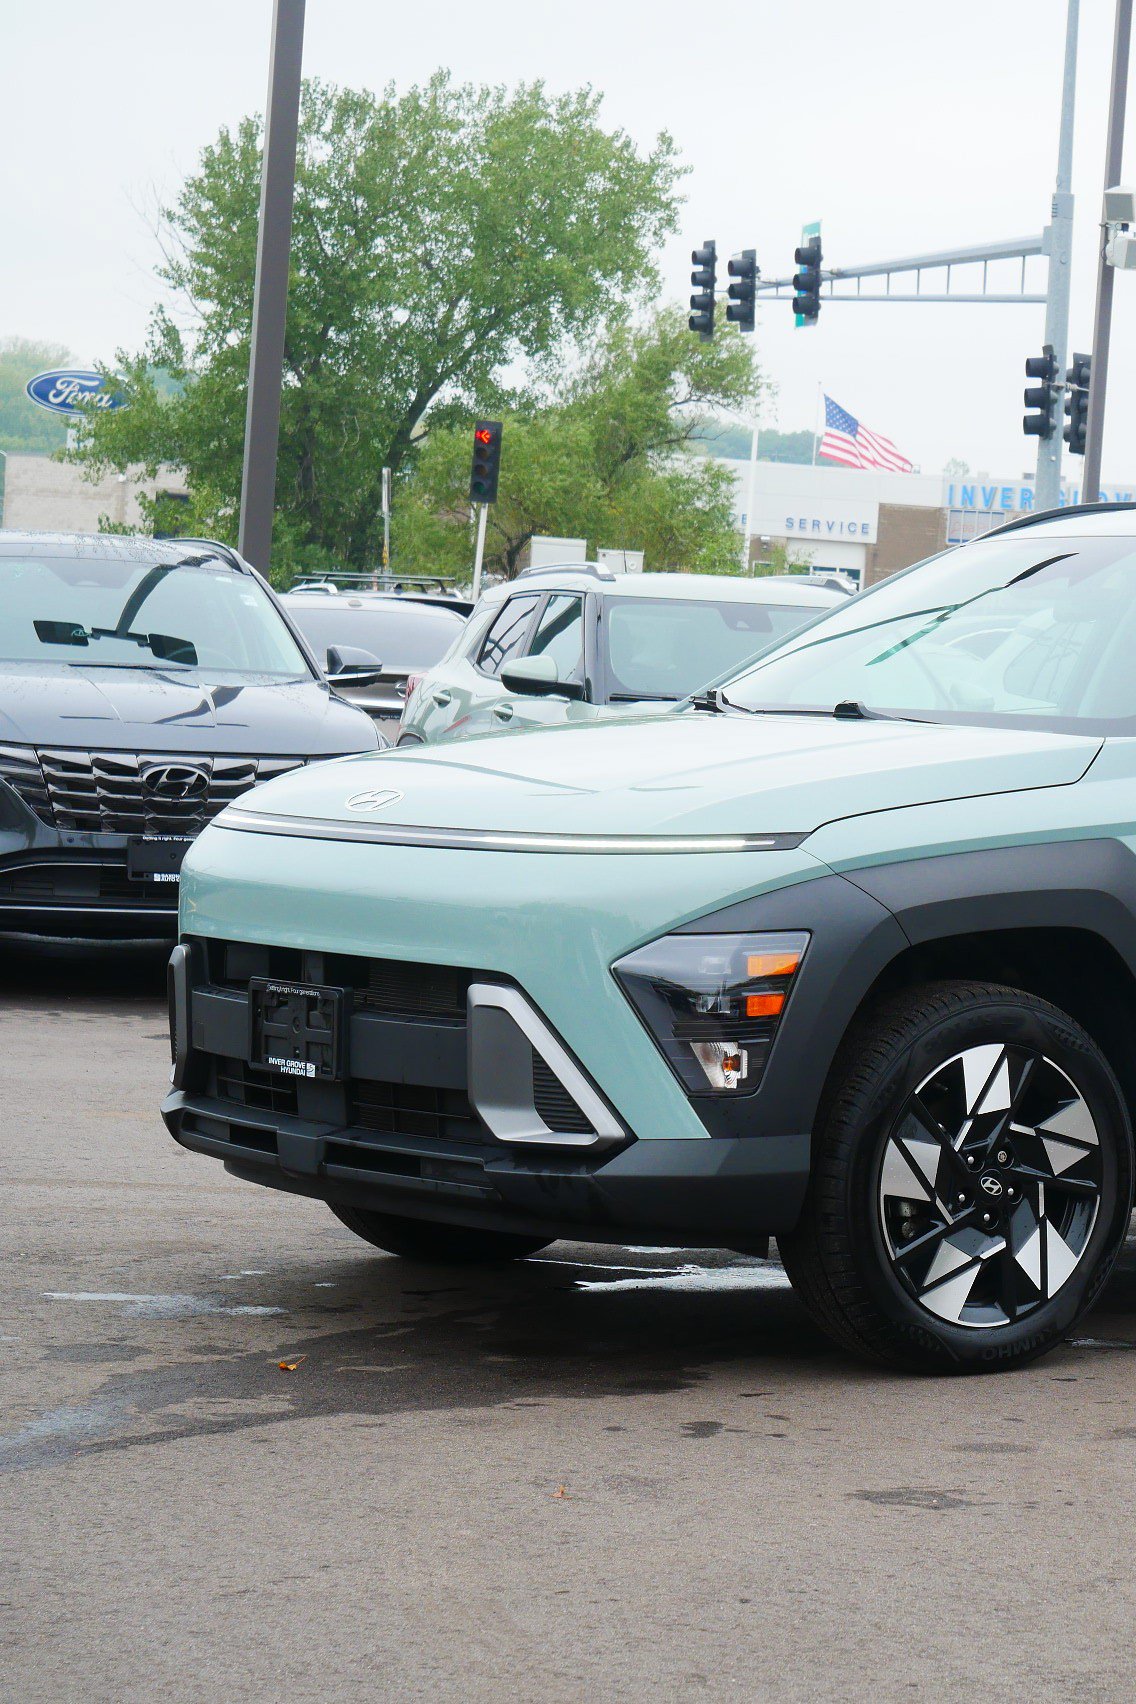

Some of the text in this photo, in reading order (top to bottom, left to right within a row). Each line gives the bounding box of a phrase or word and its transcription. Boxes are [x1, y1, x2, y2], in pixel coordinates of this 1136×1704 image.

[947, 484, 1034, 510] INVER
[785, 517, 870, 534] SERVICE
[268, 1057, 306, 1069] INVER GROVE
[280, 1066, 306, 1076] HYUNDAI
